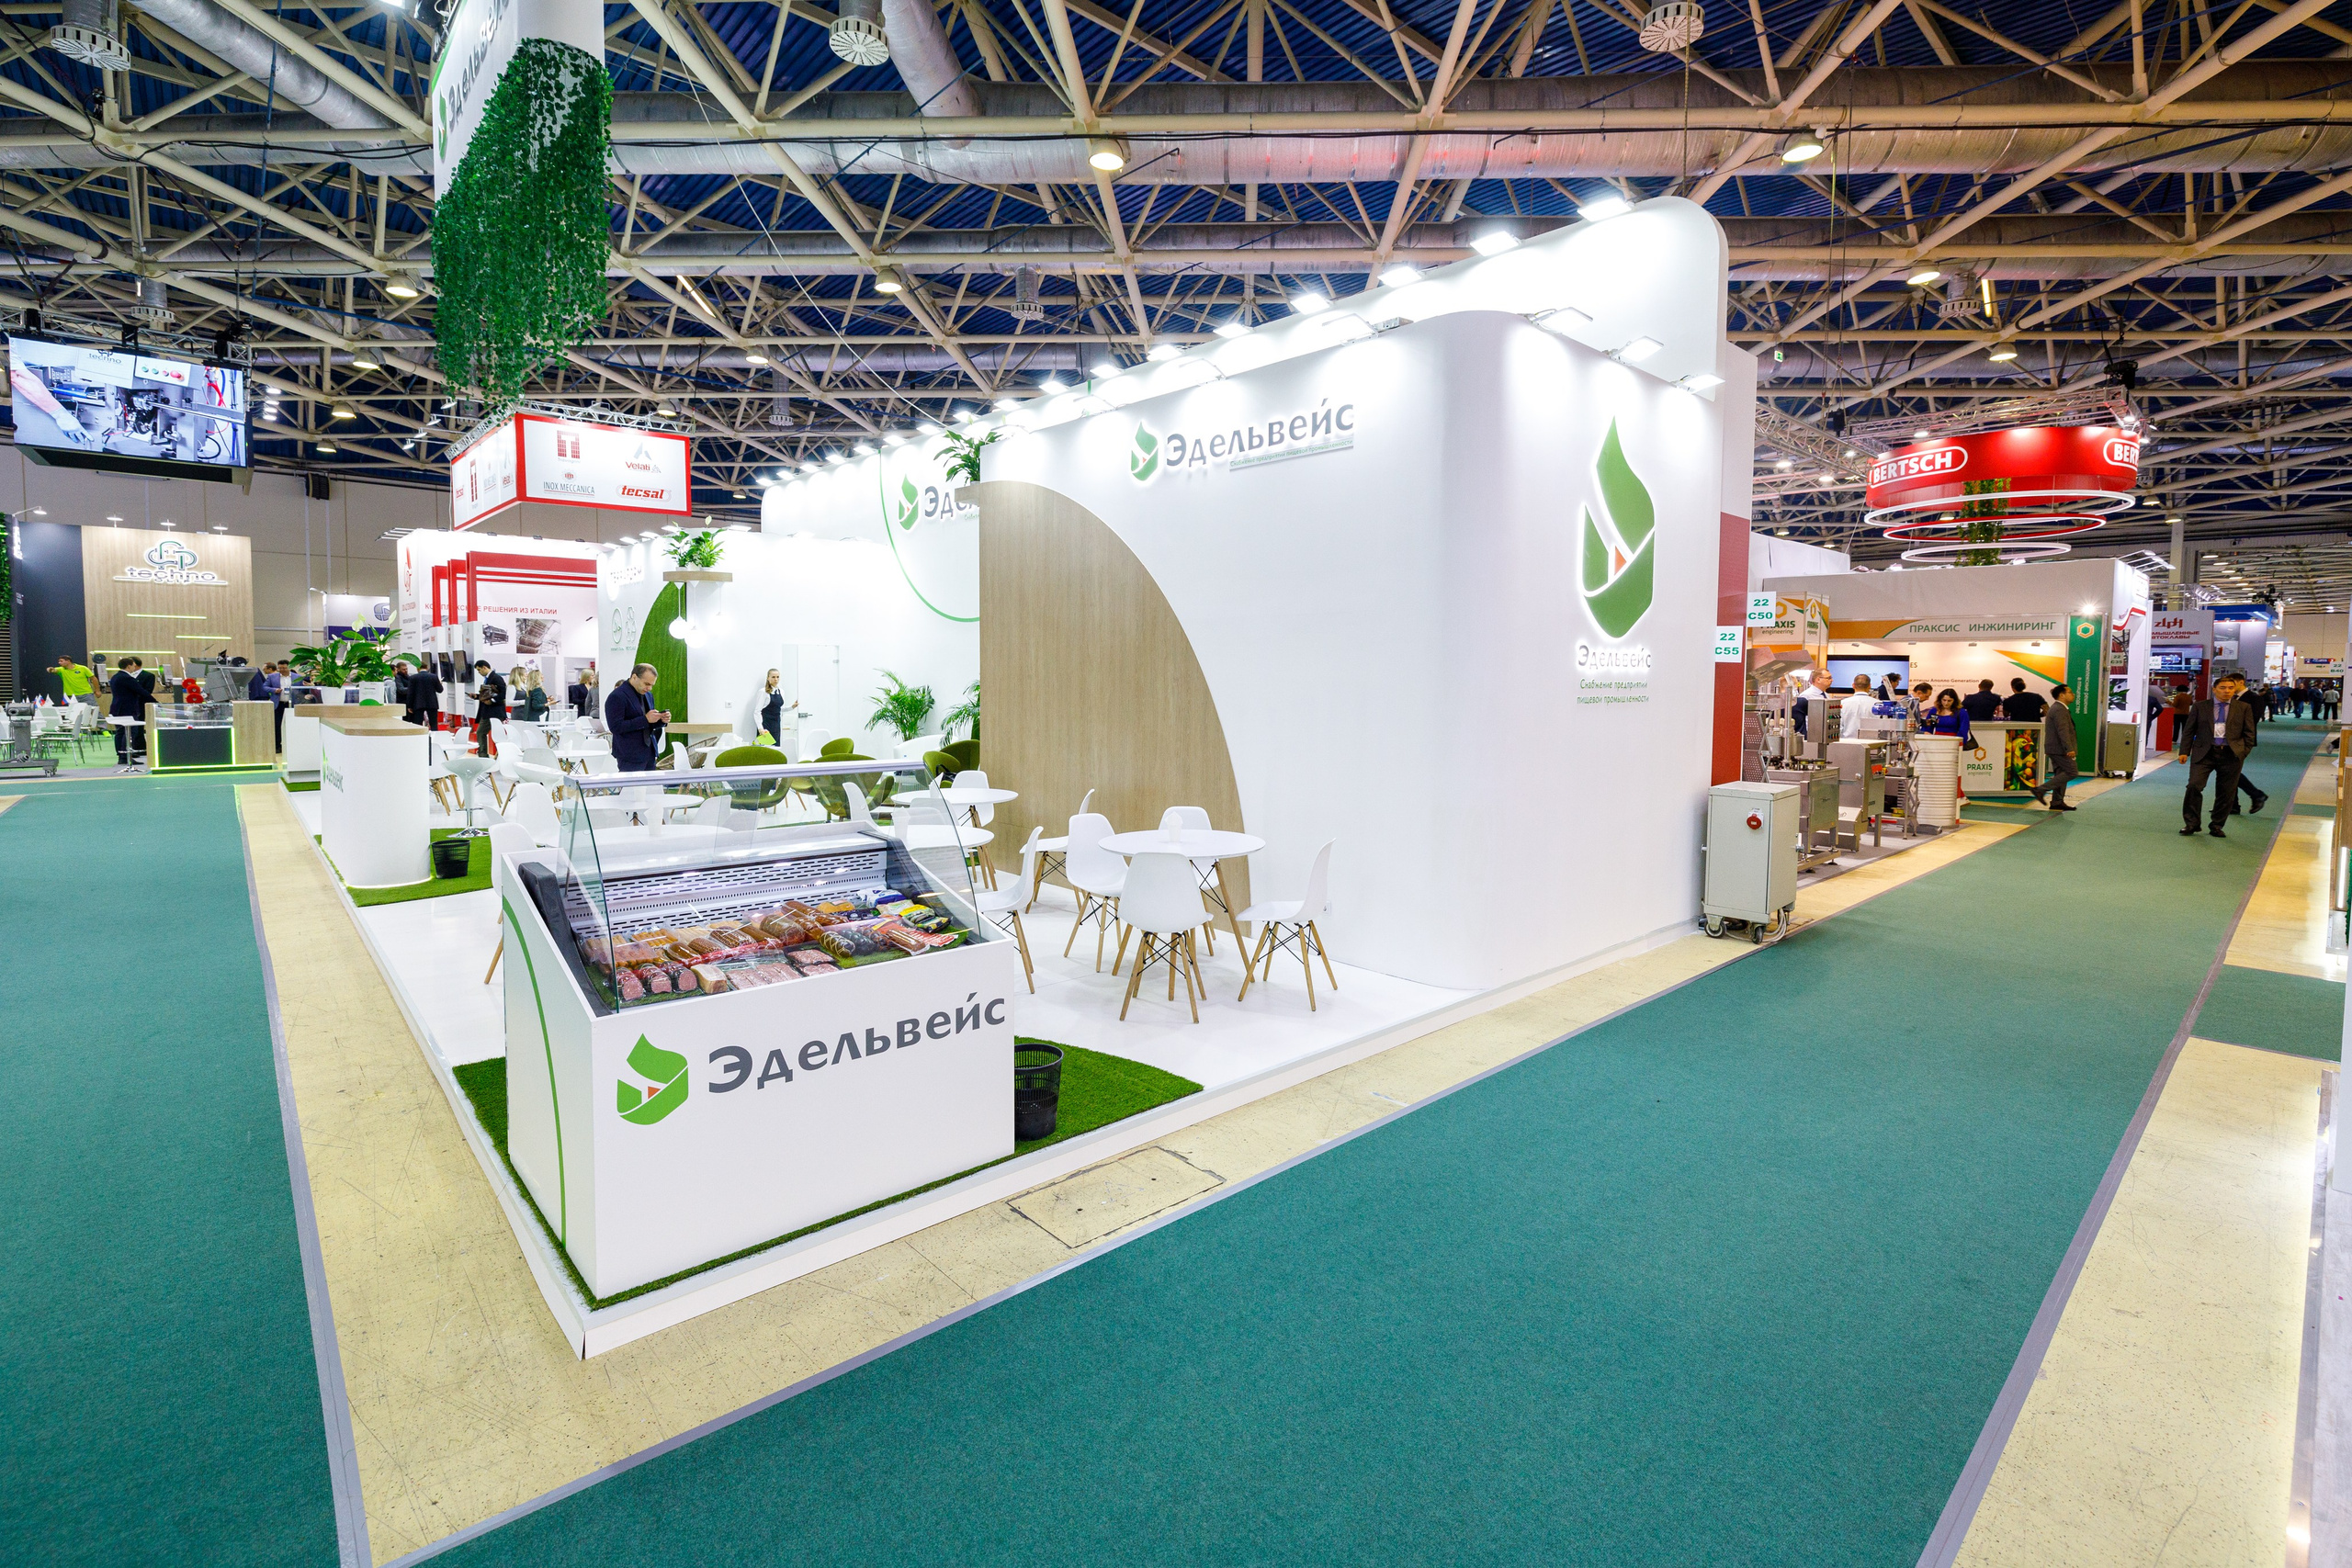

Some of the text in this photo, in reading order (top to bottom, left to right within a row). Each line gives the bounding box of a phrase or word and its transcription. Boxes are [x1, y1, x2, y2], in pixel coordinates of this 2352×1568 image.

[88, 353, 122, 364] techno
[1166, 397, 1354, 468] Эдельвейс
[1286, 448, 1308, 457] пищевой
[1308, 440, 1353, 453] промышленности
[626, 461, 650, 471] Velati
[1872, 451, 1953, 484] BERTSCH
[543, 481, 559, 491] INOX
[560, 483, 594, 495] MECCANICA
[621, 485, 665, 500] tecsal
[127, 568, 216, 581] techno
[1753, 598, 1770, 607] 22
[1747, 612, 1773, 620] C50
[1909, 621, 2057, 633] ПРАКСИС ИНЖИНИРИНГ
[1719, 633, 1736, 641] 22
[1577, 644, 1652, 670] Эдельвейс
[1714, 647, 1739, 655] C55
[1579, 678, 1648, 691] Снабжение предприятий
[1577, 694, 1650, 705] пищевой промышленности
[708, 991, 1006, 1094] Эдельвейс
